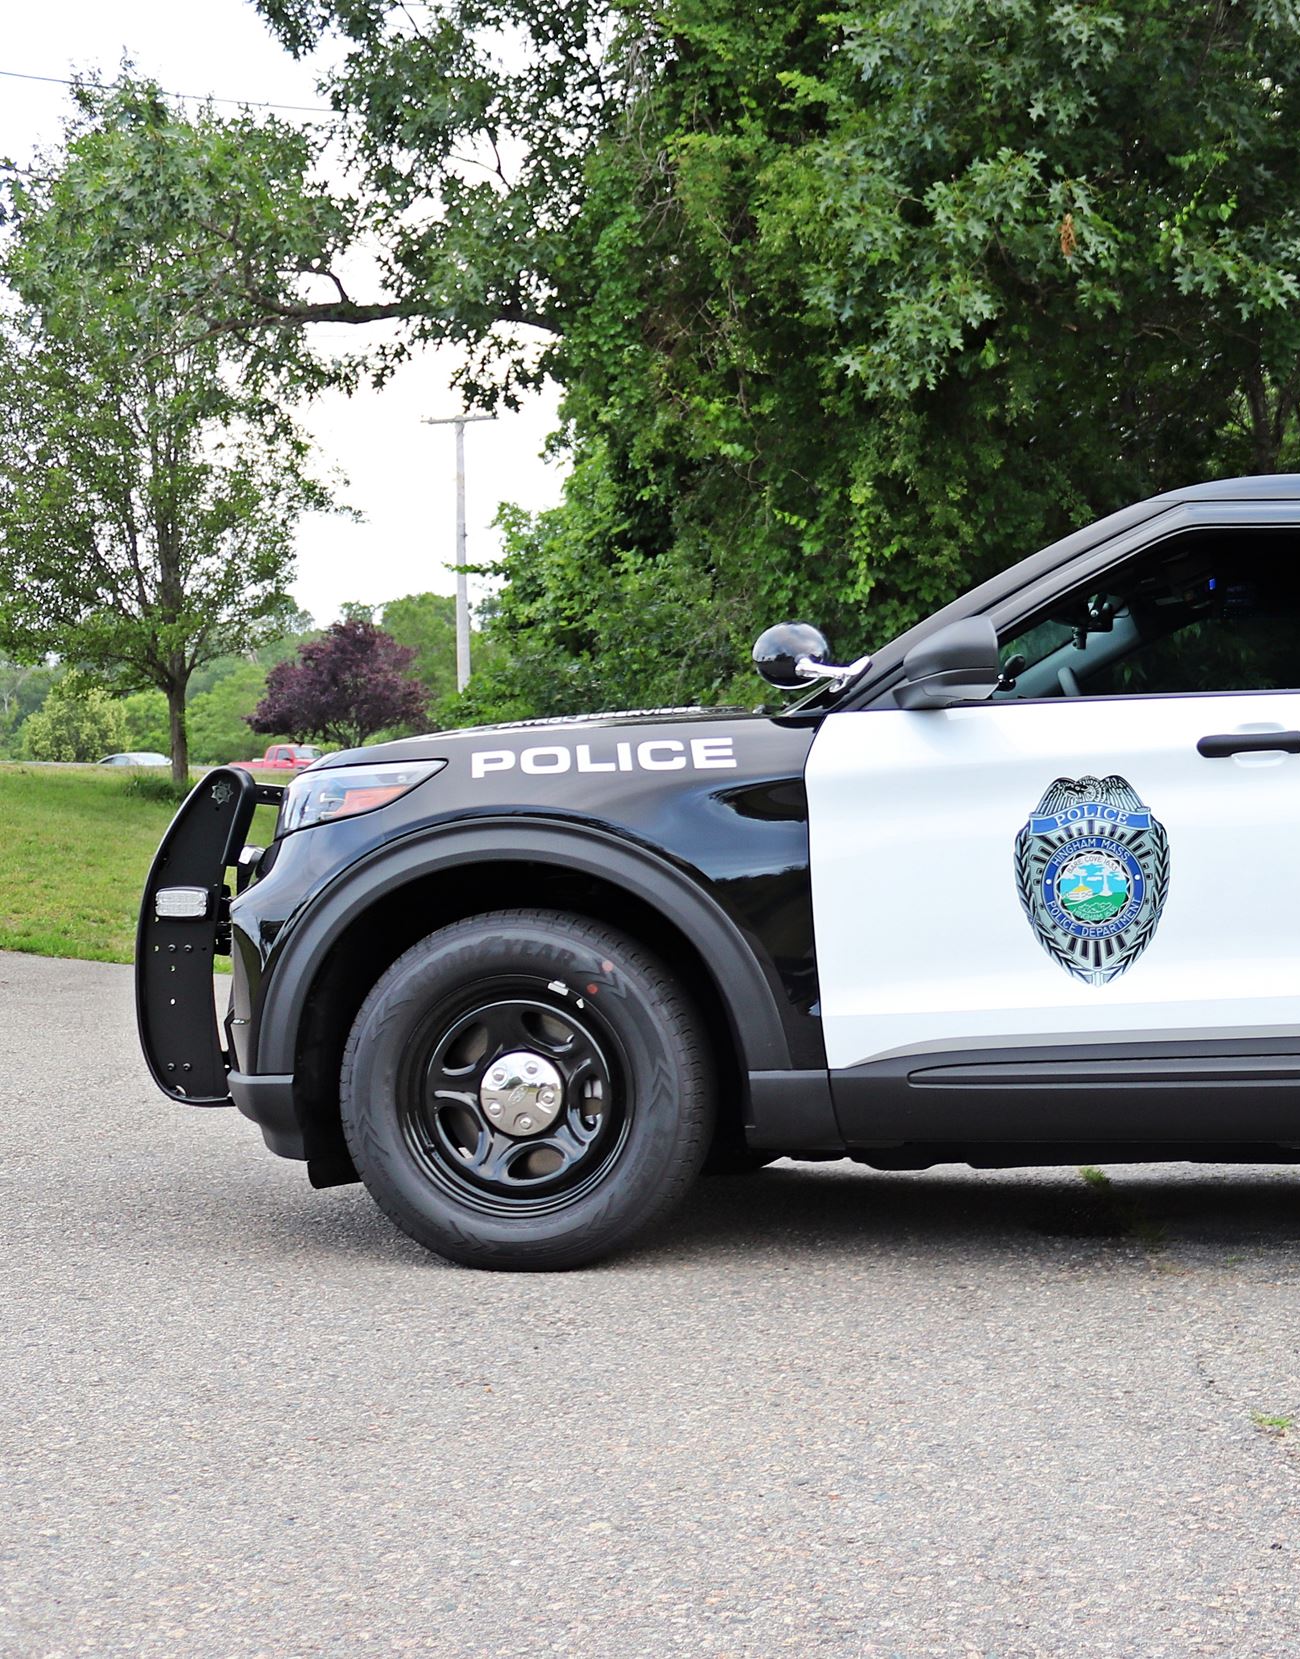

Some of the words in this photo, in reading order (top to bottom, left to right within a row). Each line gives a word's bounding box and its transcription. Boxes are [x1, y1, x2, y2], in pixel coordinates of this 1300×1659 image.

[471, 737, 737, 779] POLICE
[1054, 805, 1129, 827] POLICE
[1052, 838, 1097, 867] HINGHAM
[1084, 855, 1102, 864] COVE
[1047, 901, 1076, 933] POLICE
[1081, 898, 1141, 938] DEPARTMENT
